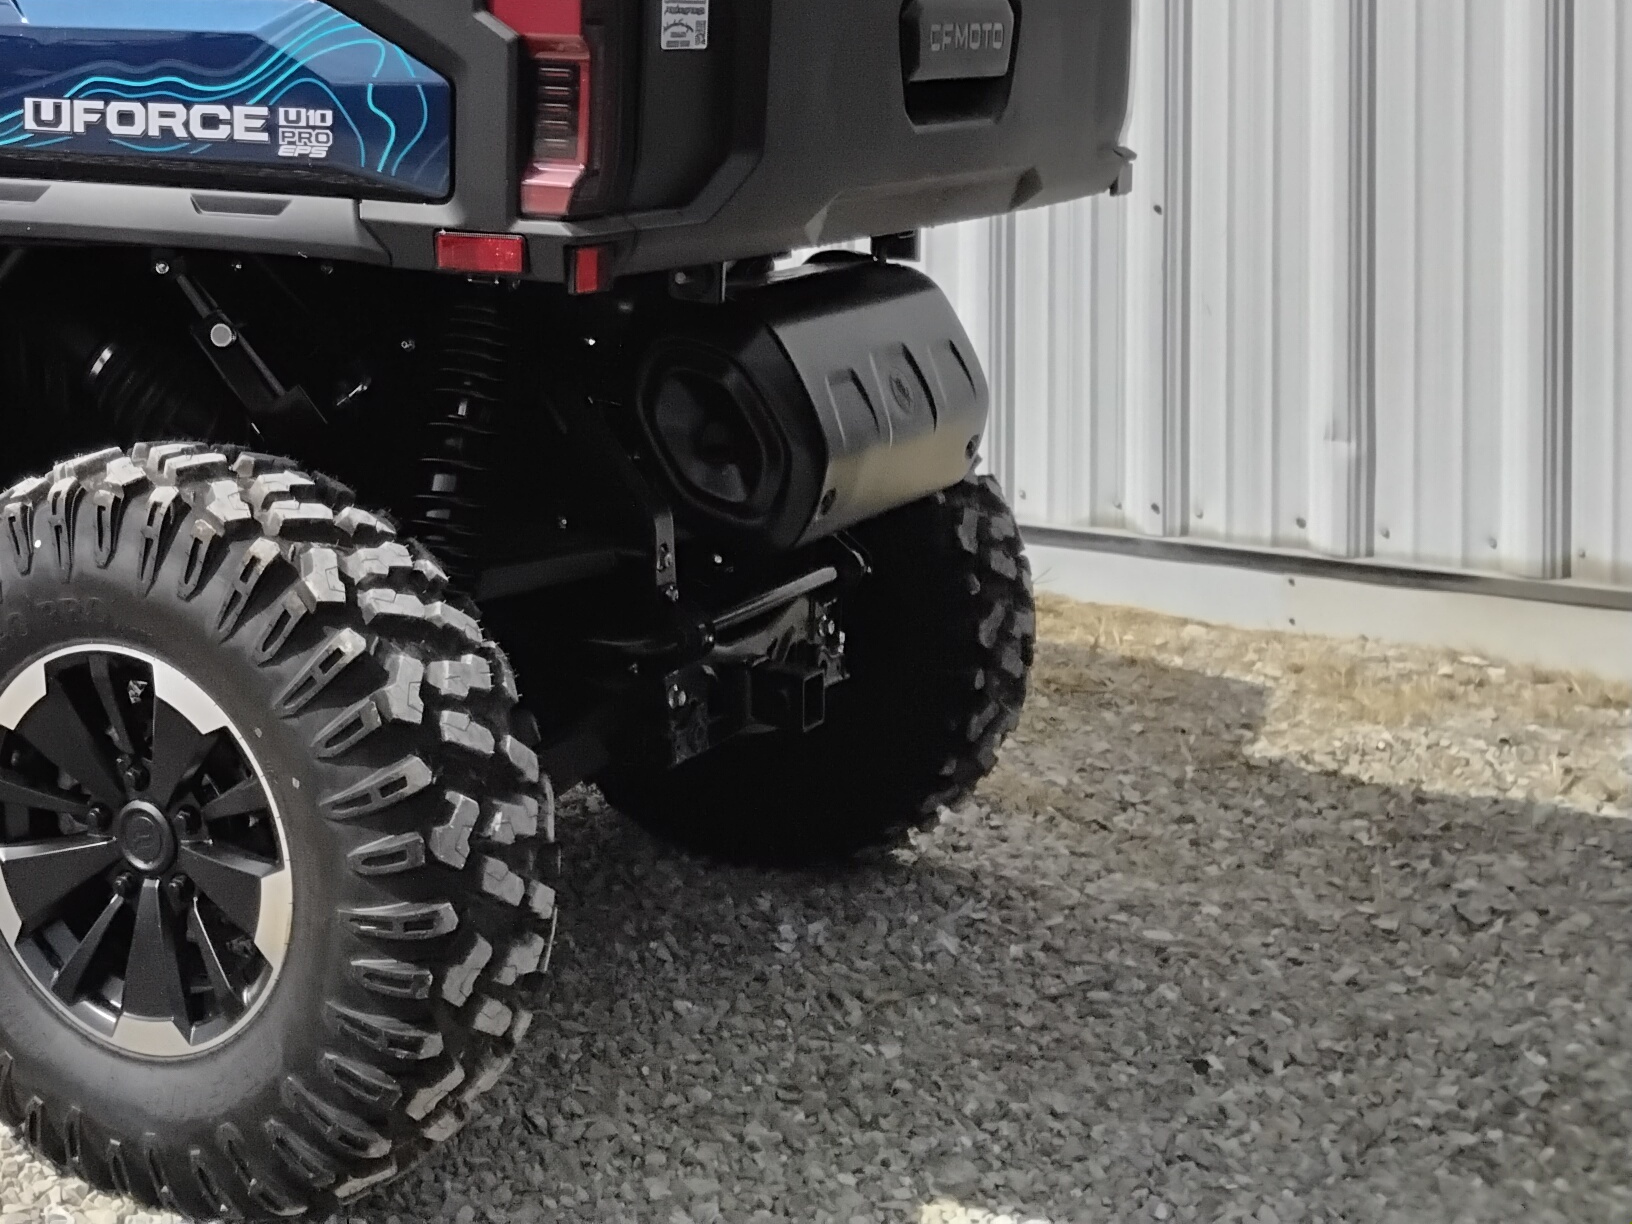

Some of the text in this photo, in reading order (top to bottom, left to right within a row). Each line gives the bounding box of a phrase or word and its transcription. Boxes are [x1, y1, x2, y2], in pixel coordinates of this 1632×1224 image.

[929, 21, 1005, 52] CFMOTO
[24, 97, 270, 143] UFORCE
[278, 107, 334, 127] U10
[278, 128, 333, 147] PRO
[277, 145, 329, 158] EPS
